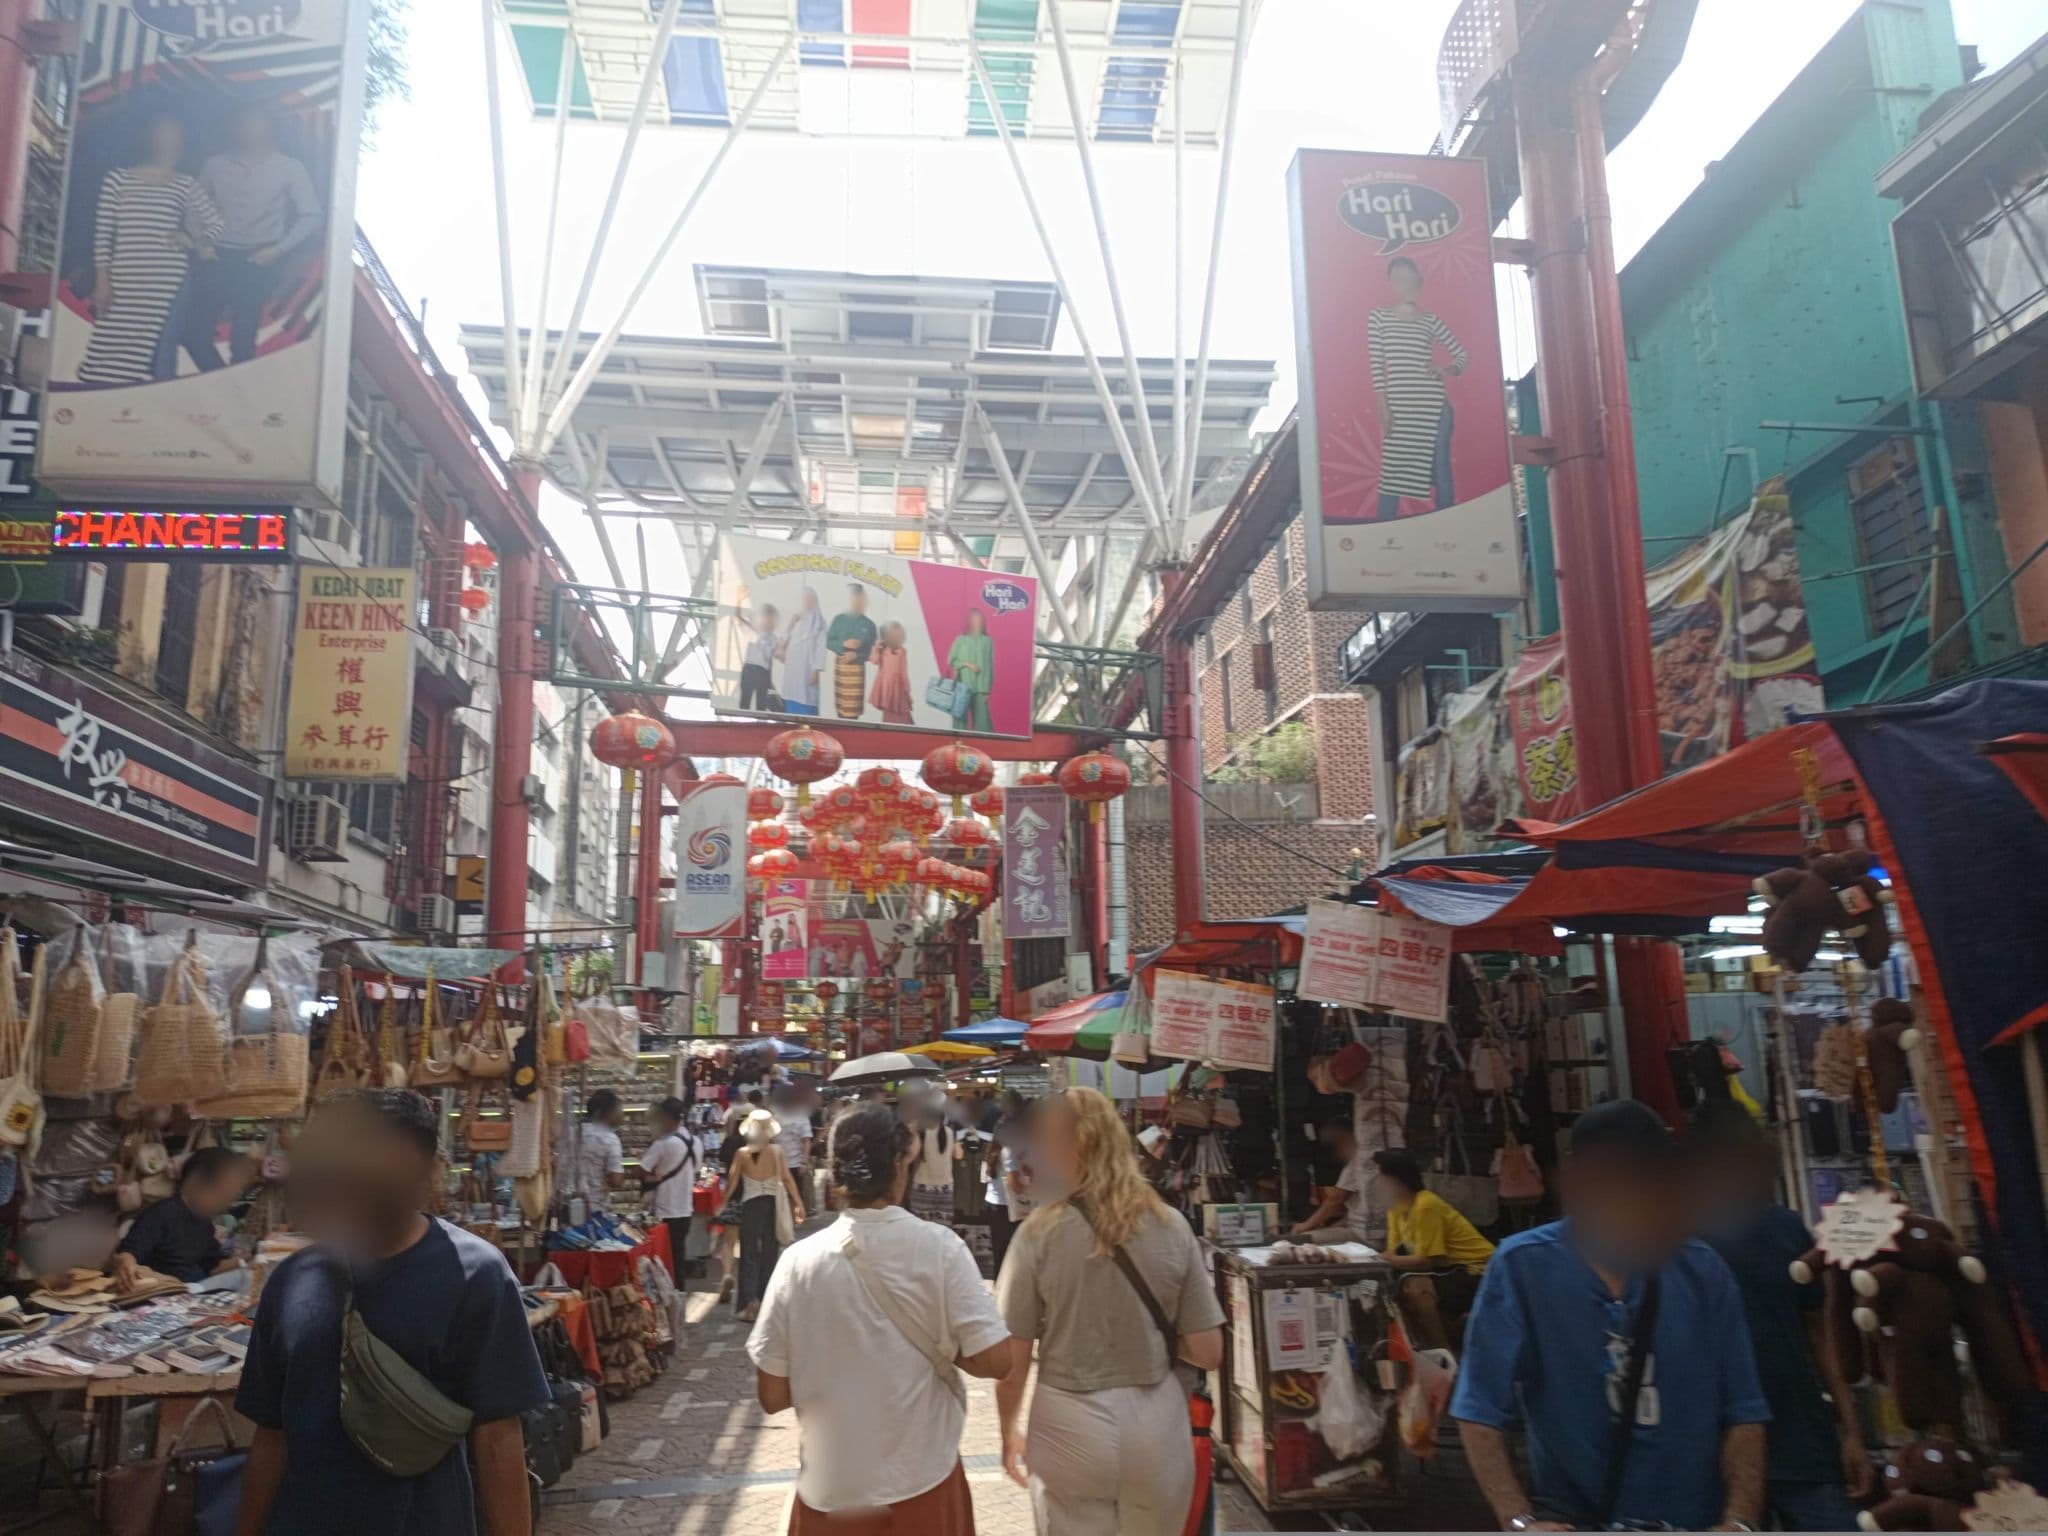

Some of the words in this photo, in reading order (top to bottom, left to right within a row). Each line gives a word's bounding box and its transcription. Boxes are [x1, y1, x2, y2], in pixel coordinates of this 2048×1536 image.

[195, 6, 283, 39] Hari
[1347, 188, 1414, 215] Hari
[1384, 212, 1449, 240] Hari
[53, 514, 243, 548] CHANGE
[311, 576, 358, 597] KEDAI
[984, 584, 1012, 597] Hari
[998, 597, 1027, 610] Hari
[304, 602, 355, 631] KEEN
[362, 603, 404, 632] HING
[319, 633, 386, 652] Enterprise
[687, 873, 730, 886] ASEAN
